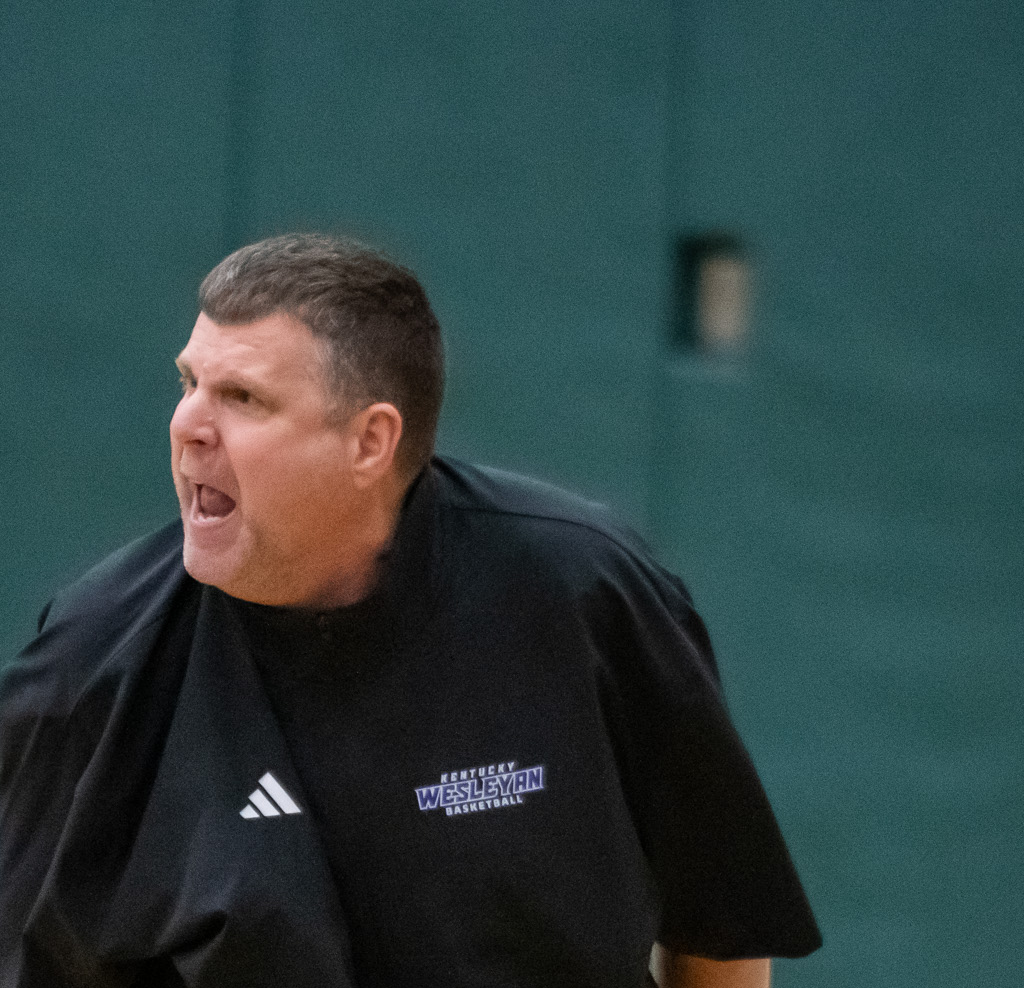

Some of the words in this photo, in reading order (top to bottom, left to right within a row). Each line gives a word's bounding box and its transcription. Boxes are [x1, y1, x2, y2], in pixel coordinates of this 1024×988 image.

[440, 761, 515, 784] KENTUCKY
[414, 765, 545, 811] WESLEYAN
[445, 794, 523, 817] BASKETBALL
